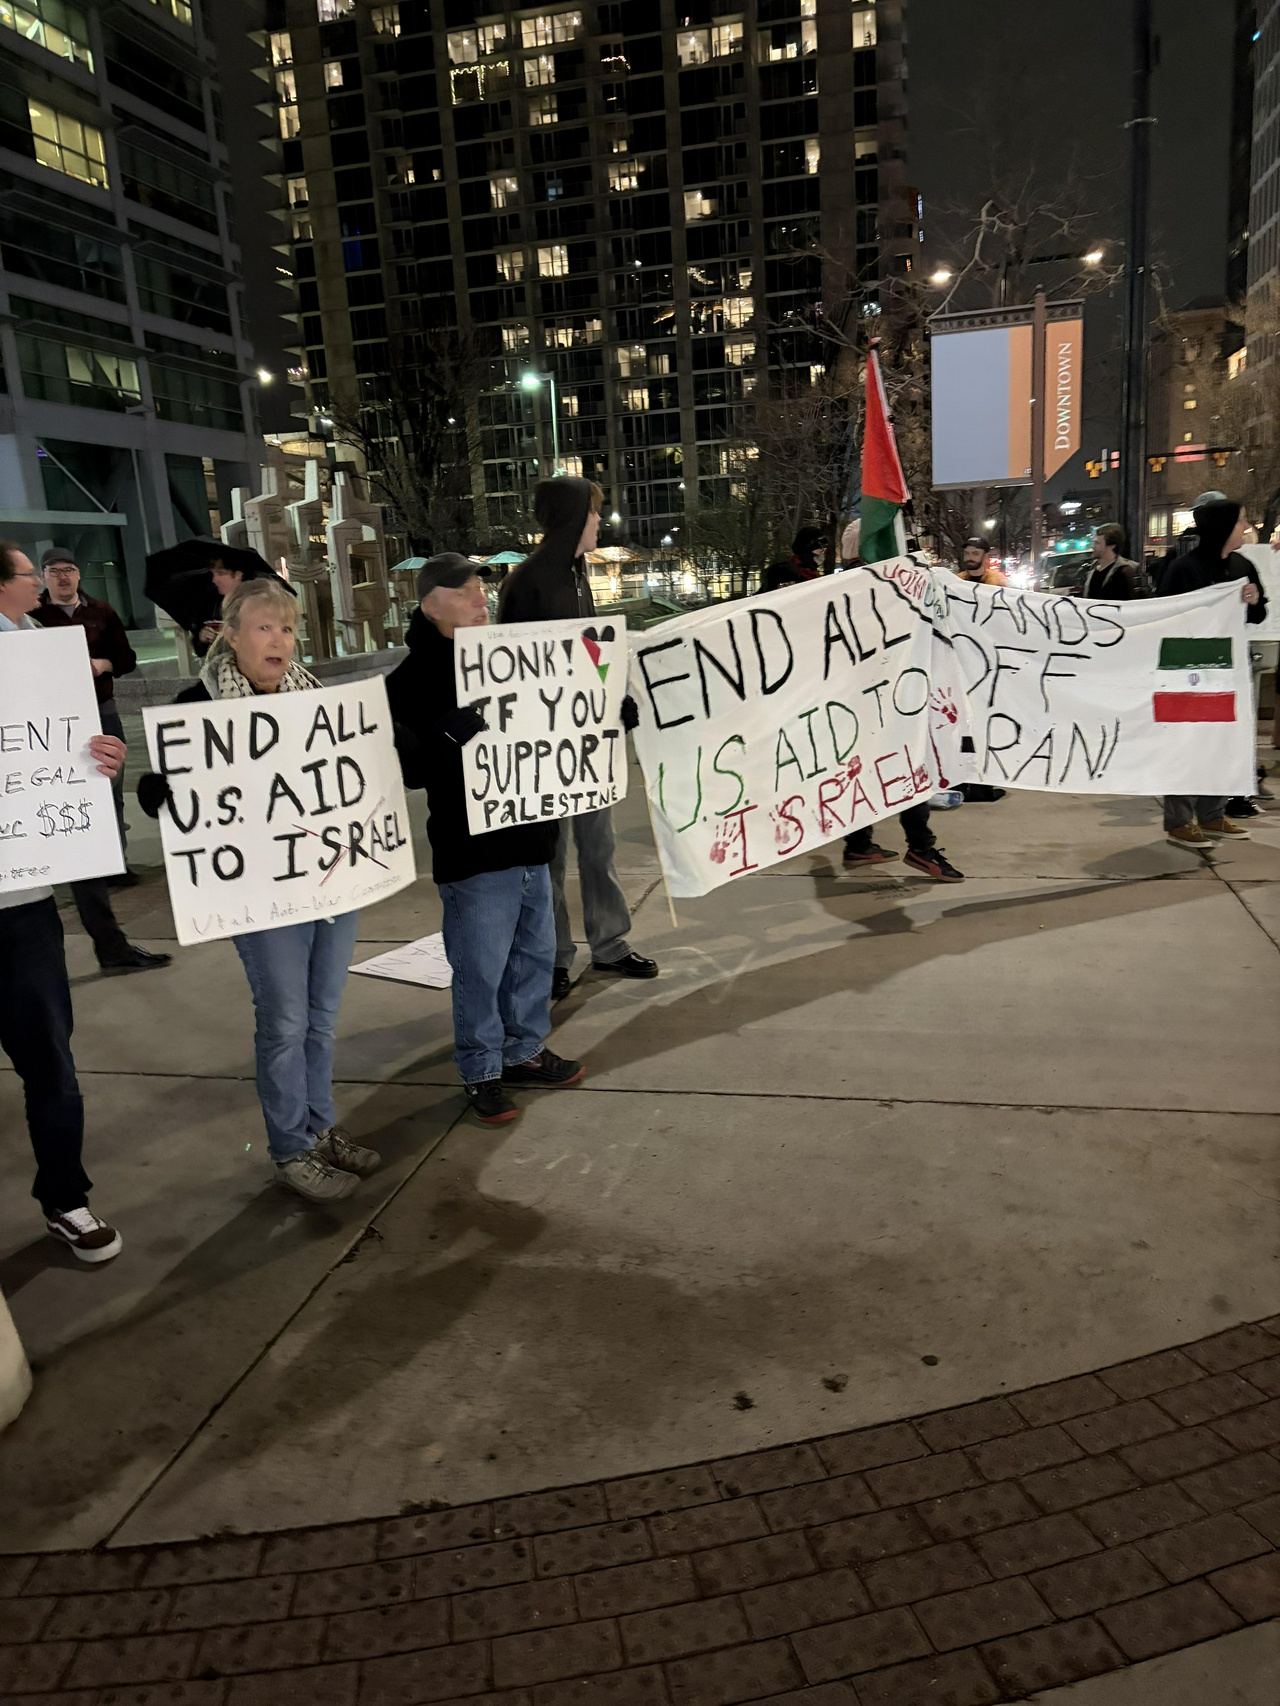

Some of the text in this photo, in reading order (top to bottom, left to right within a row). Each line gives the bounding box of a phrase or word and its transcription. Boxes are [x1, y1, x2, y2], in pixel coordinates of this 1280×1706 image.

[1054, 342, 1073, 450] DOWNTOWN
[944, 583, 1126, 648] HANDS
[460, 638, 574, 692] HONK!
[637, 588, 912, 731] END ALL
[156, 701, 379, 776] END ALL
[538, 686, 607, 732] YOU
[0, 766, 87, 798] EGAL
[471, 729, 620, 801] SUPPORT
[658, 667, 931, 834] U.S. AID TO
[36, 798, 94, 839] $$$
[167, 755, 367, 835] U.S. AID
[724, 720, 950, 878] ISRAEL!
[170, 811, 407, 887] TO ISRAEL
